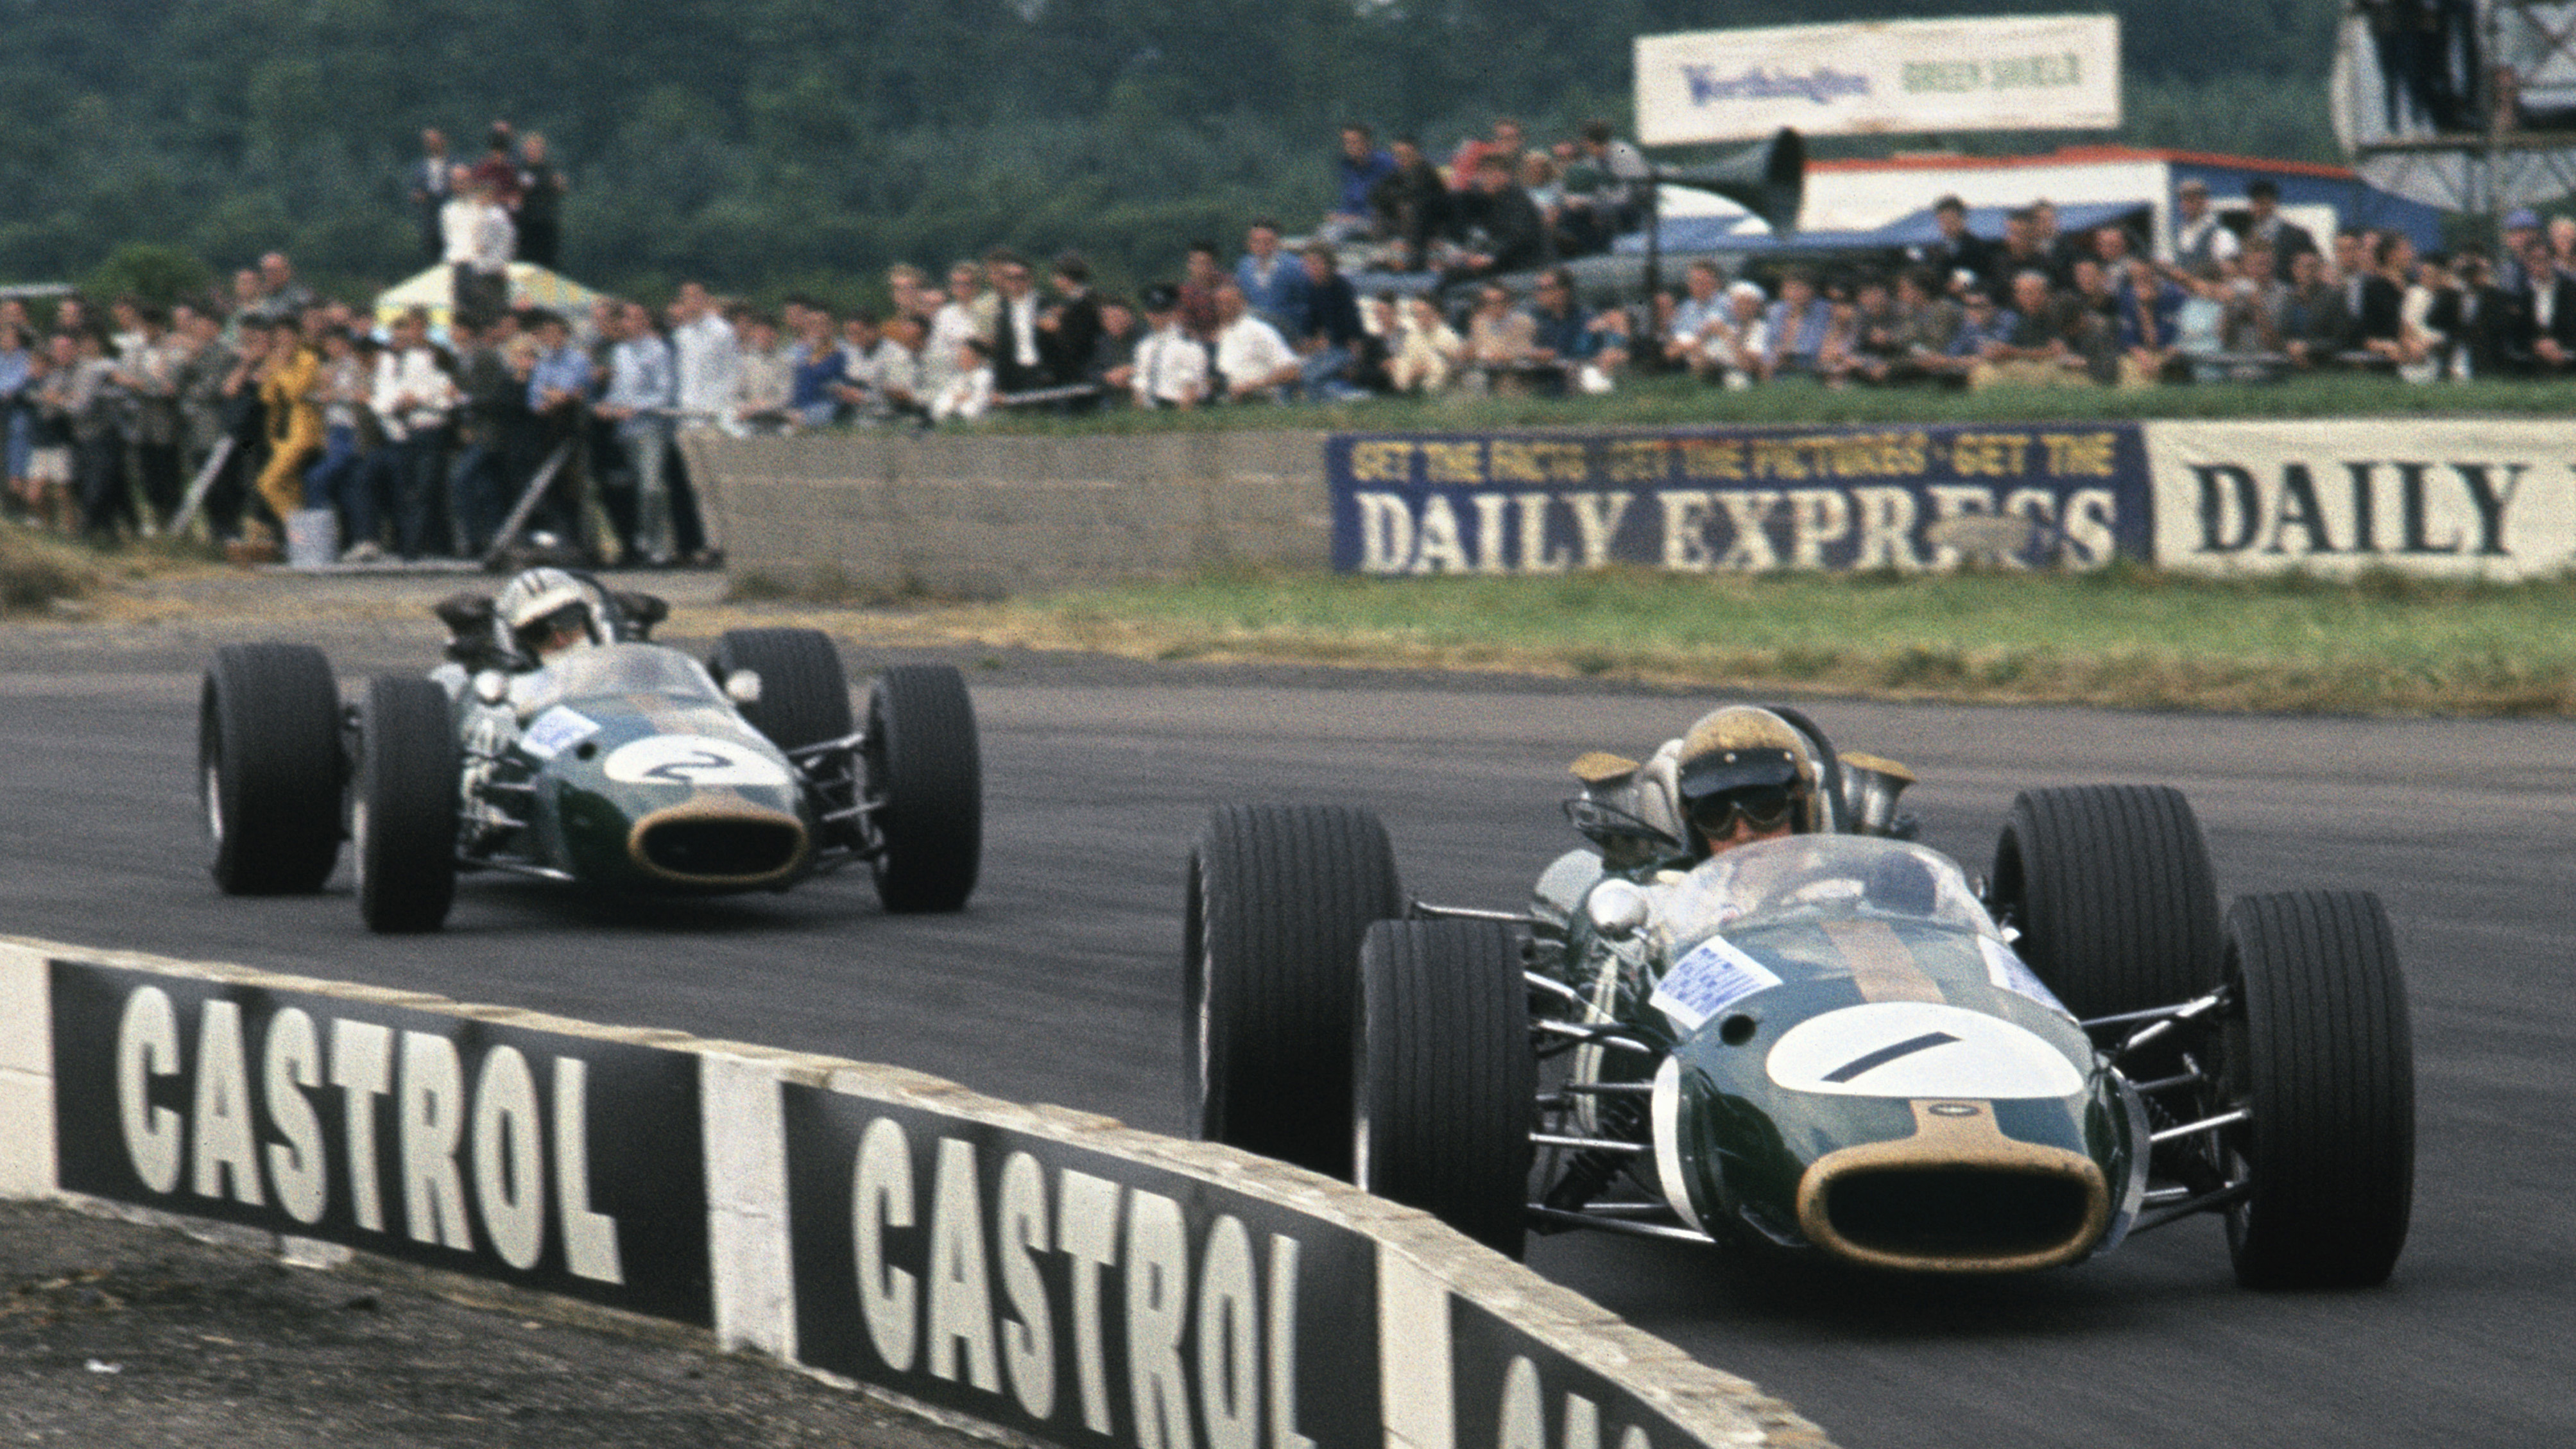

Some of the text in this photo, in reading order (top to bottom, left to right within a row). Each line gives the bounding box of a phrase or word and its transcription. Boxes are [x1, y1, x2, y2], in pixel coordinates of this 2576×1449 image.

[1352, 442, 1413, 481] GET
[1423, 442, 1482, 482] THE
[1490, 440, 1588, 482] FACTS
[1752, 433, 1925, 479] PICTURES
[1953, 433, 2031, 476] GET
[2041, 433, 2116, 476] THE
[1354, 492, 1635, 574] DAILY
[2186, 459, 2530, 556] DAILY
[642, 750, 735, 782] 2
[1820, 1031, 1964, 1083] 1
[116, 986, 626, 1284] CASTROL
[852, 1117, 1318, 1449] CASTROL
